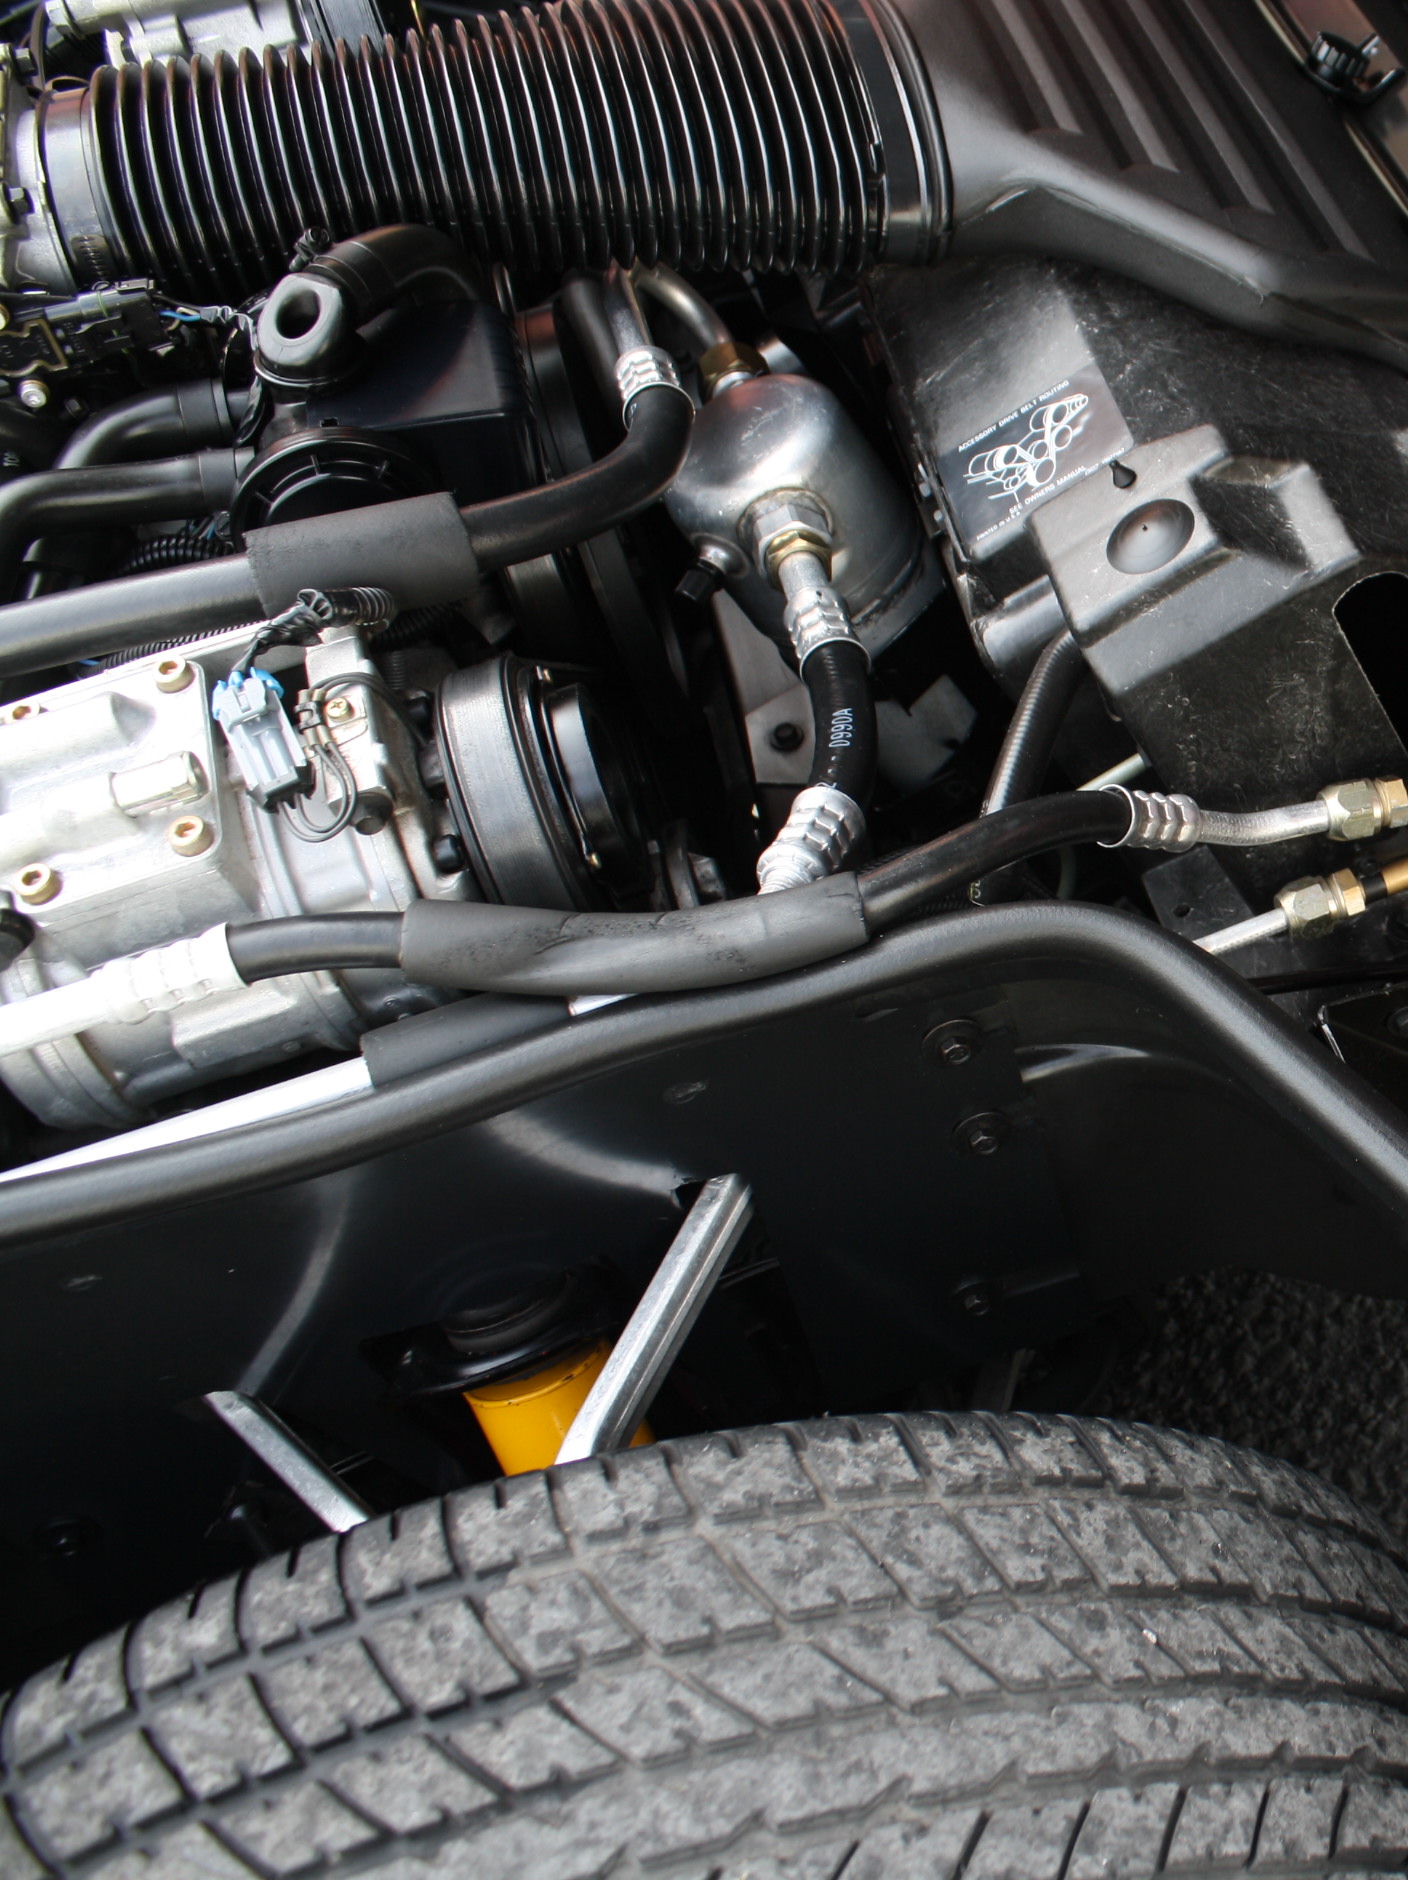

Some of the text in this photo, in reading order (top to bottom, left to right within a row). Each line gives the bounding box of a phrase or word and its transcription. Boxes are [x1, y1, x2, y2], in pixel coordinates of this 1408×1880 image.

[958, 379, 1070, 453] ACCESSORY DRIVE BELT ROUTING
[1008, 502, 1024, 515] SEE
[1024, 484, 1056, 505] OWNERS
[1056, 465, 1088, 486] MANUAL
